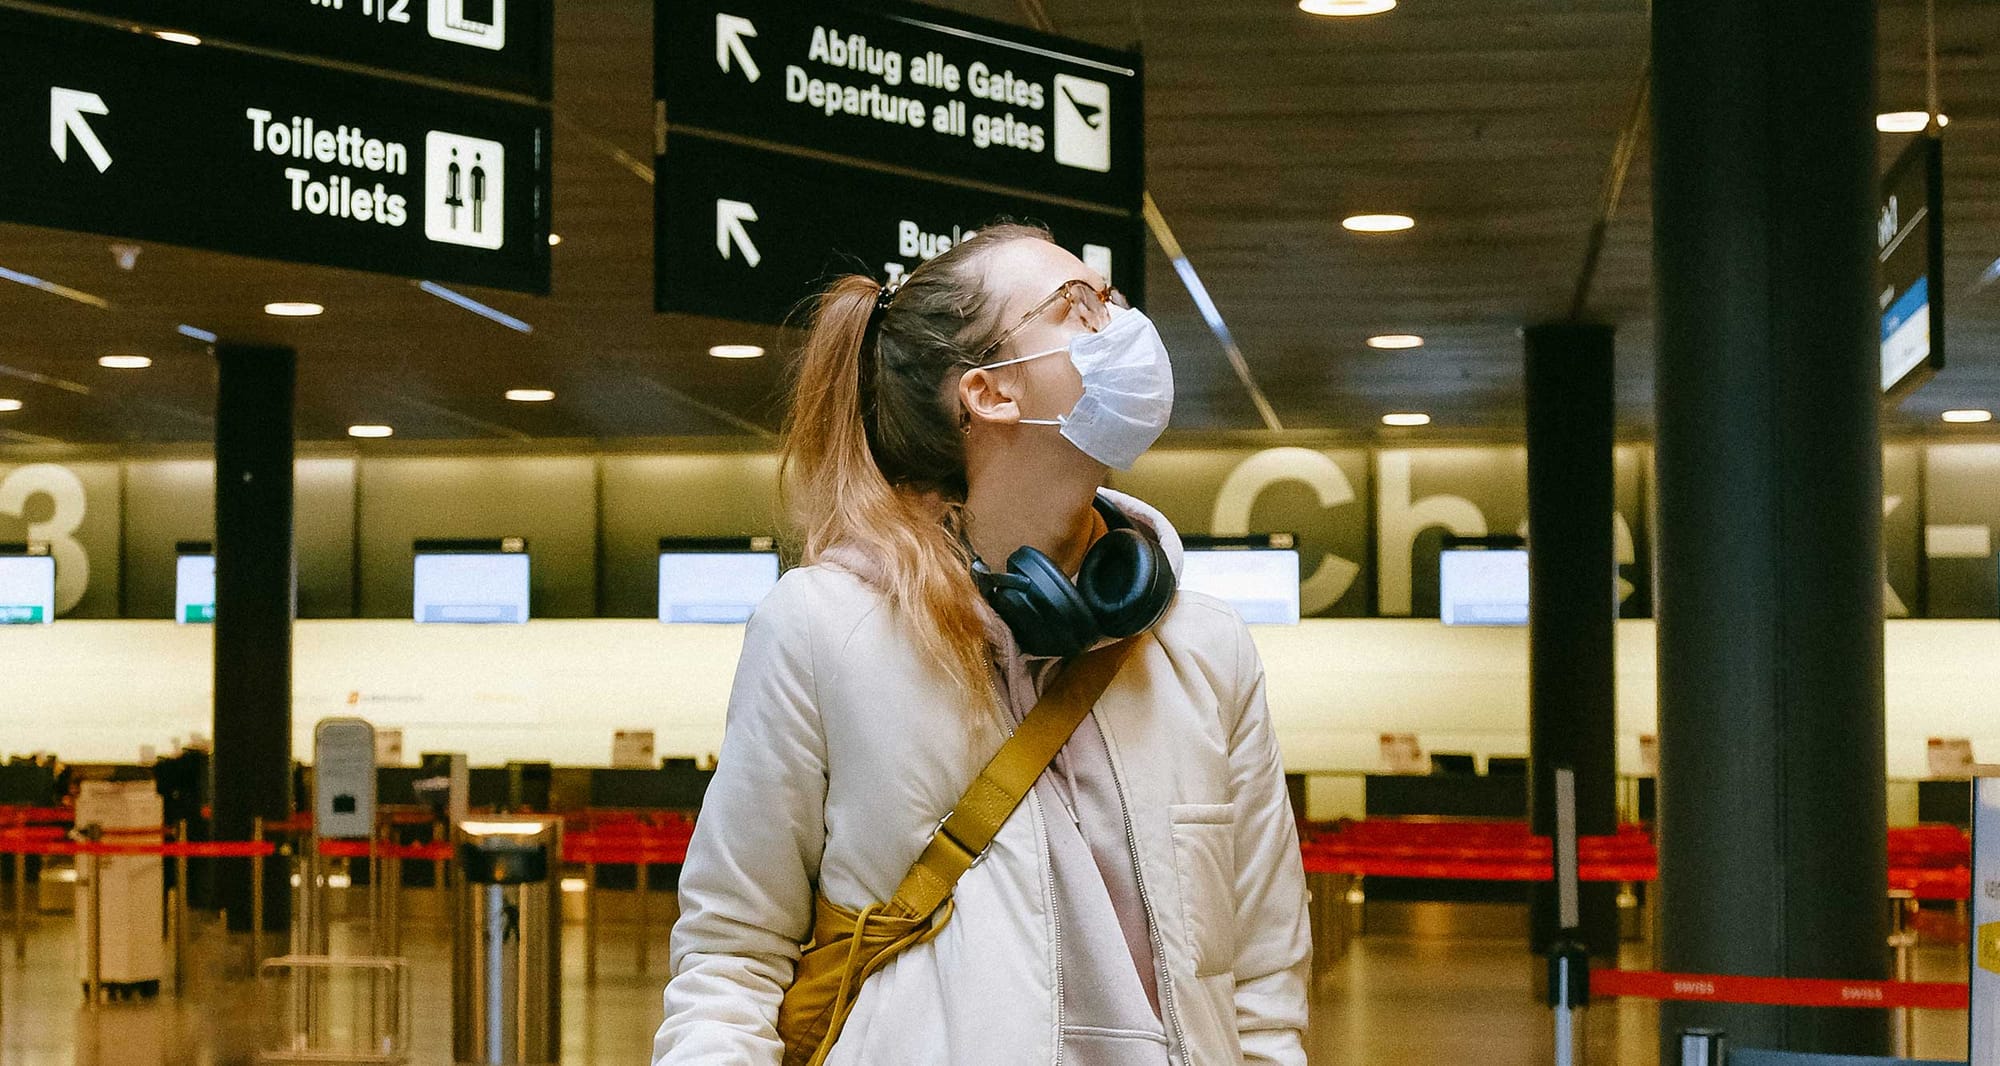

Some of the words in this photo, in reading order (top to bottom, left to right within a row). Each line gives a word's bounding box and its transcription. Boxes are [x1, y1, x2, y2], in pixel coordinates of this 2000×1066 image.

[808, 25, 902, 86] Abflug
[909, 51, 961, 92] alle
[967, 61, 1045, 110] Gates
[246, 107, 407, 176] Toiletten
[785, 64, 926, 128] Departure
[932, 99, 966, 137] all
[972, 112, 1045, 153] gates
[284, 167, 408, 227] Toilets
